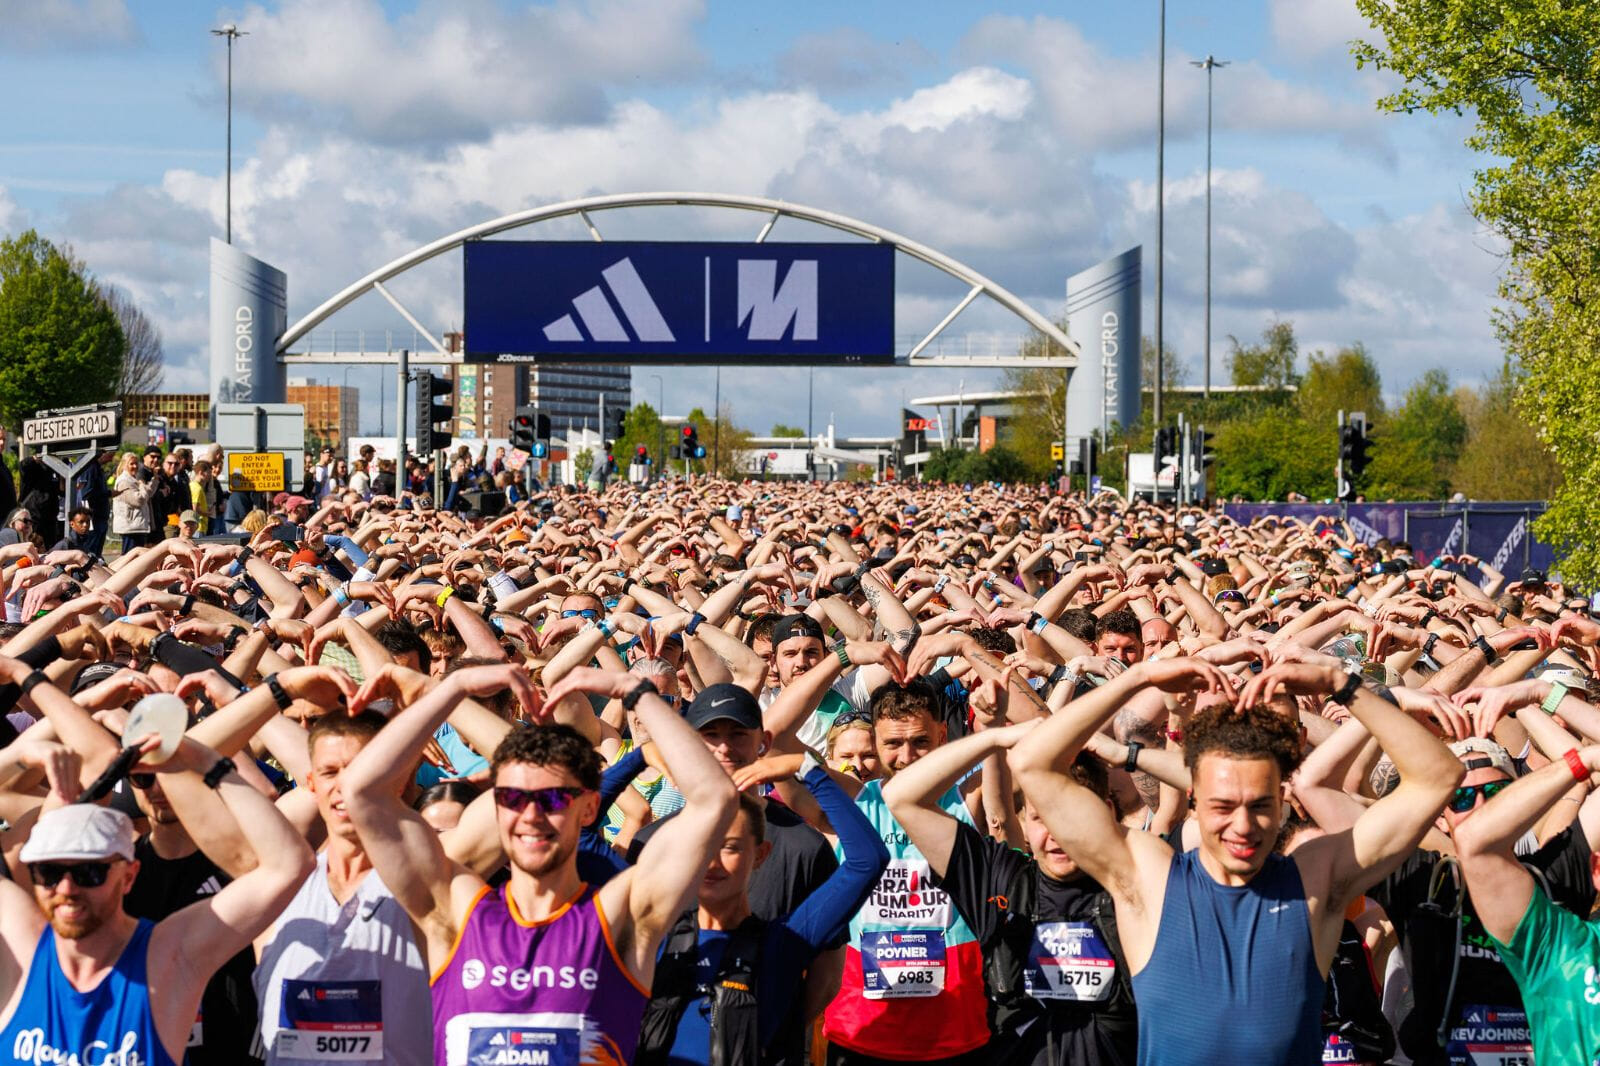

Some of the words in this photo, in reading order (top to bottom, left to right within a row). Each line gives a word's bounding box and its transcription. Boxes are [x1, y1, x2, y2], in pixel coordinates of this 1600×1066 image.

[236, 306, 252, 403] RAFFORD
[26, 418, 75, 441] CHESTER
[79, 414, 109, 436] ROAD
[908, 418, 938, 431] KFC
[886, 868, 908, 878] THE
[879, 908, 935, 918] CHARITY
[877, 946, 928, 959] POYNER
[1051, 942, 1082, 956] TOM
[490, 965, 598, 991] sense
[898, 970, 934, 984] 6983
[1057, 971, 1102, 986] 15715
[1451, 1027, 1476, 1040] KEV
[1477, 1027, 1531, 1041] JOHNSO
[316, 1036, 371, 1053] 50177
[494, 1049, 549, 1065] ADAM
